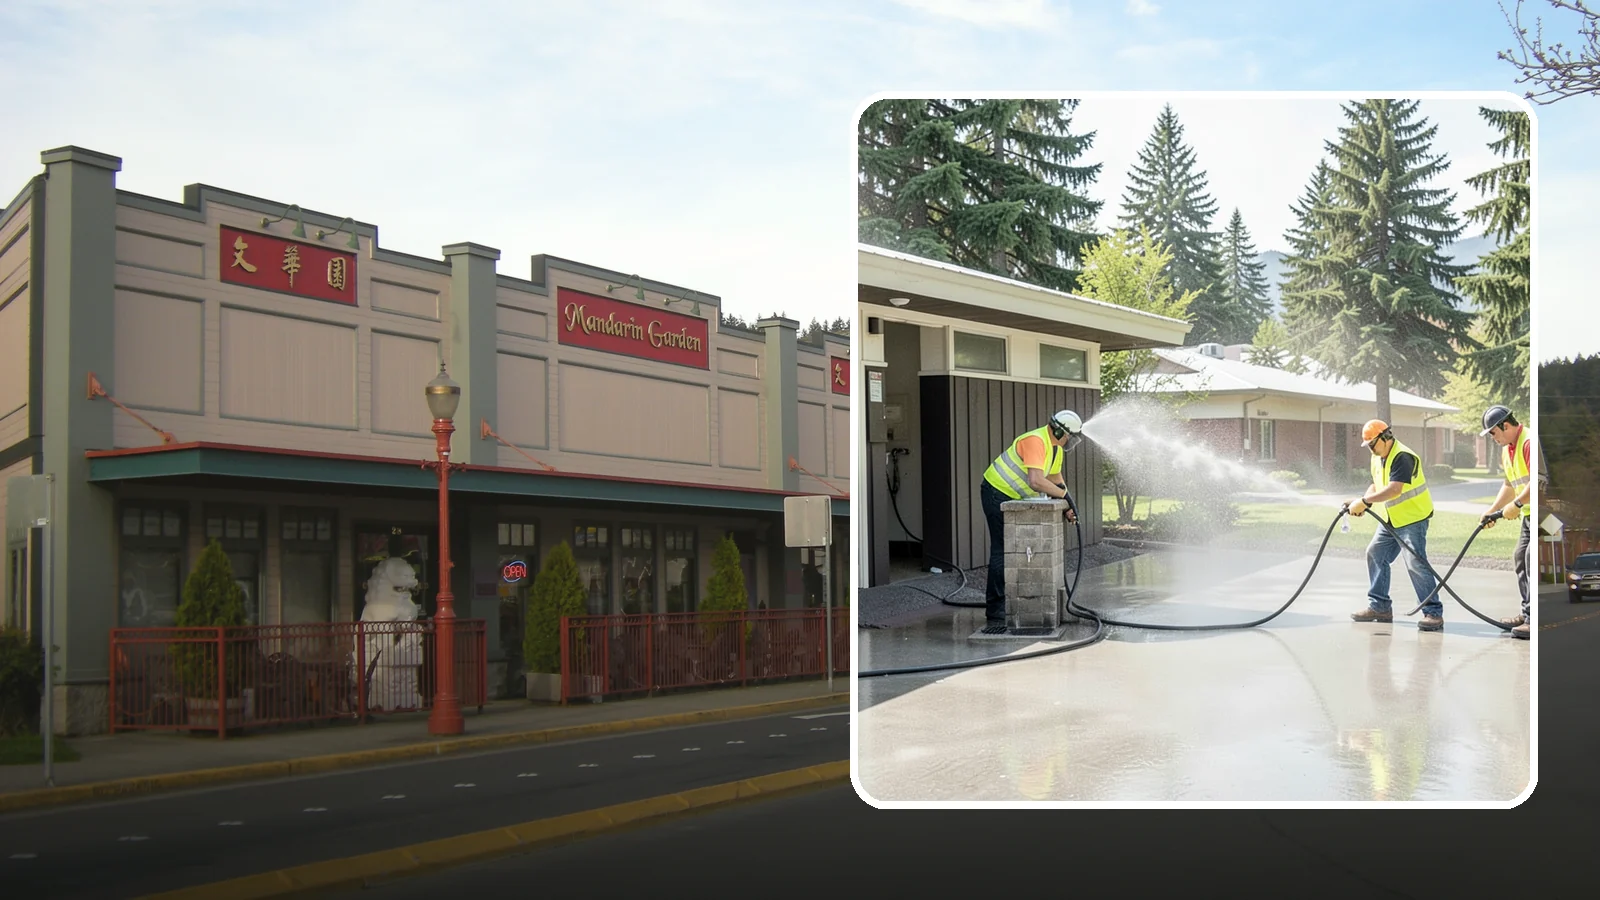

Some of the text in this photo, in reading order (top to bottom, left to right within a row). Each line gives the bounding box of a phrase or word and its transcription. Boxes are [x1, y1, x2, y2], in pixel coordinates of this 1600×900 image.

[231, 235, 346, 291] 文華園
[564, 302, 702, 352] Mandarin Garden
[503, 565, 527, 578] OPEN
